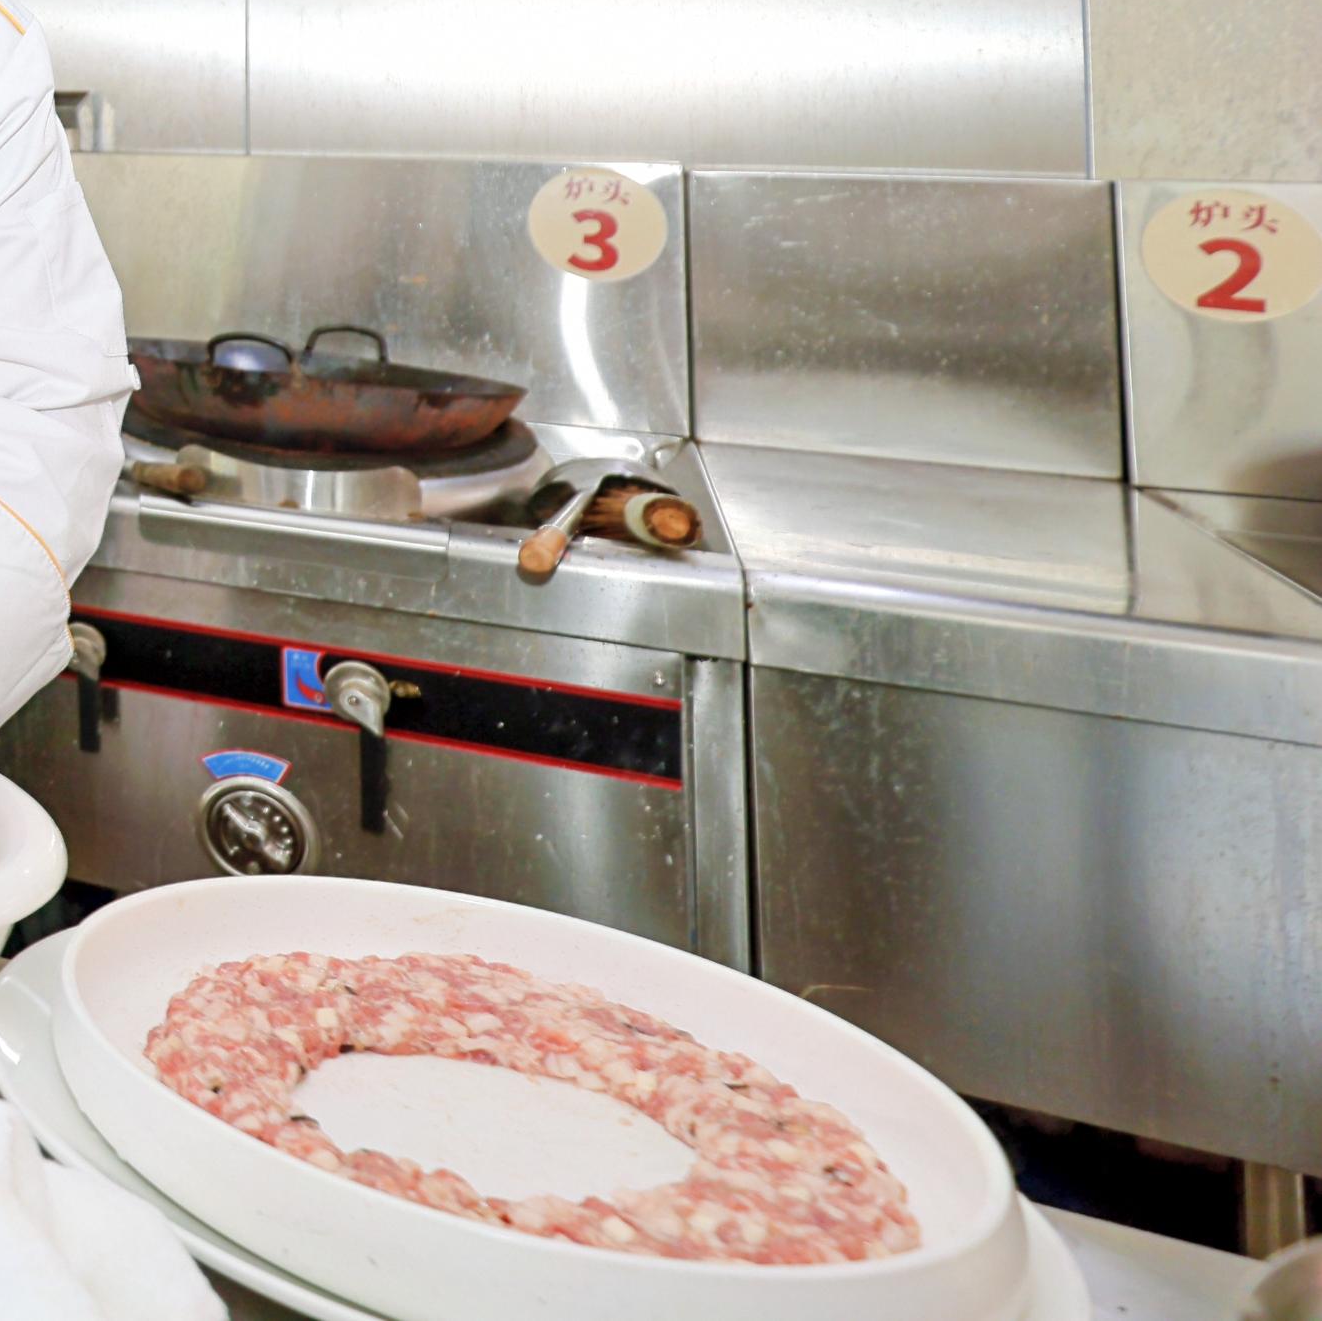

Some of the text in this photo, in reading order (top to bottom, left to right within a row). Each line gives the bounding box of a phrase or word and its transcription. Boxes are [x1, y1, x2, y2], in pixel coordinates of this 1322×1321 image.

[567, 209, 619, 272] 3
[1188, 200, 1280, 234] 炉头
[1197, 237, 1266, 313] 2
